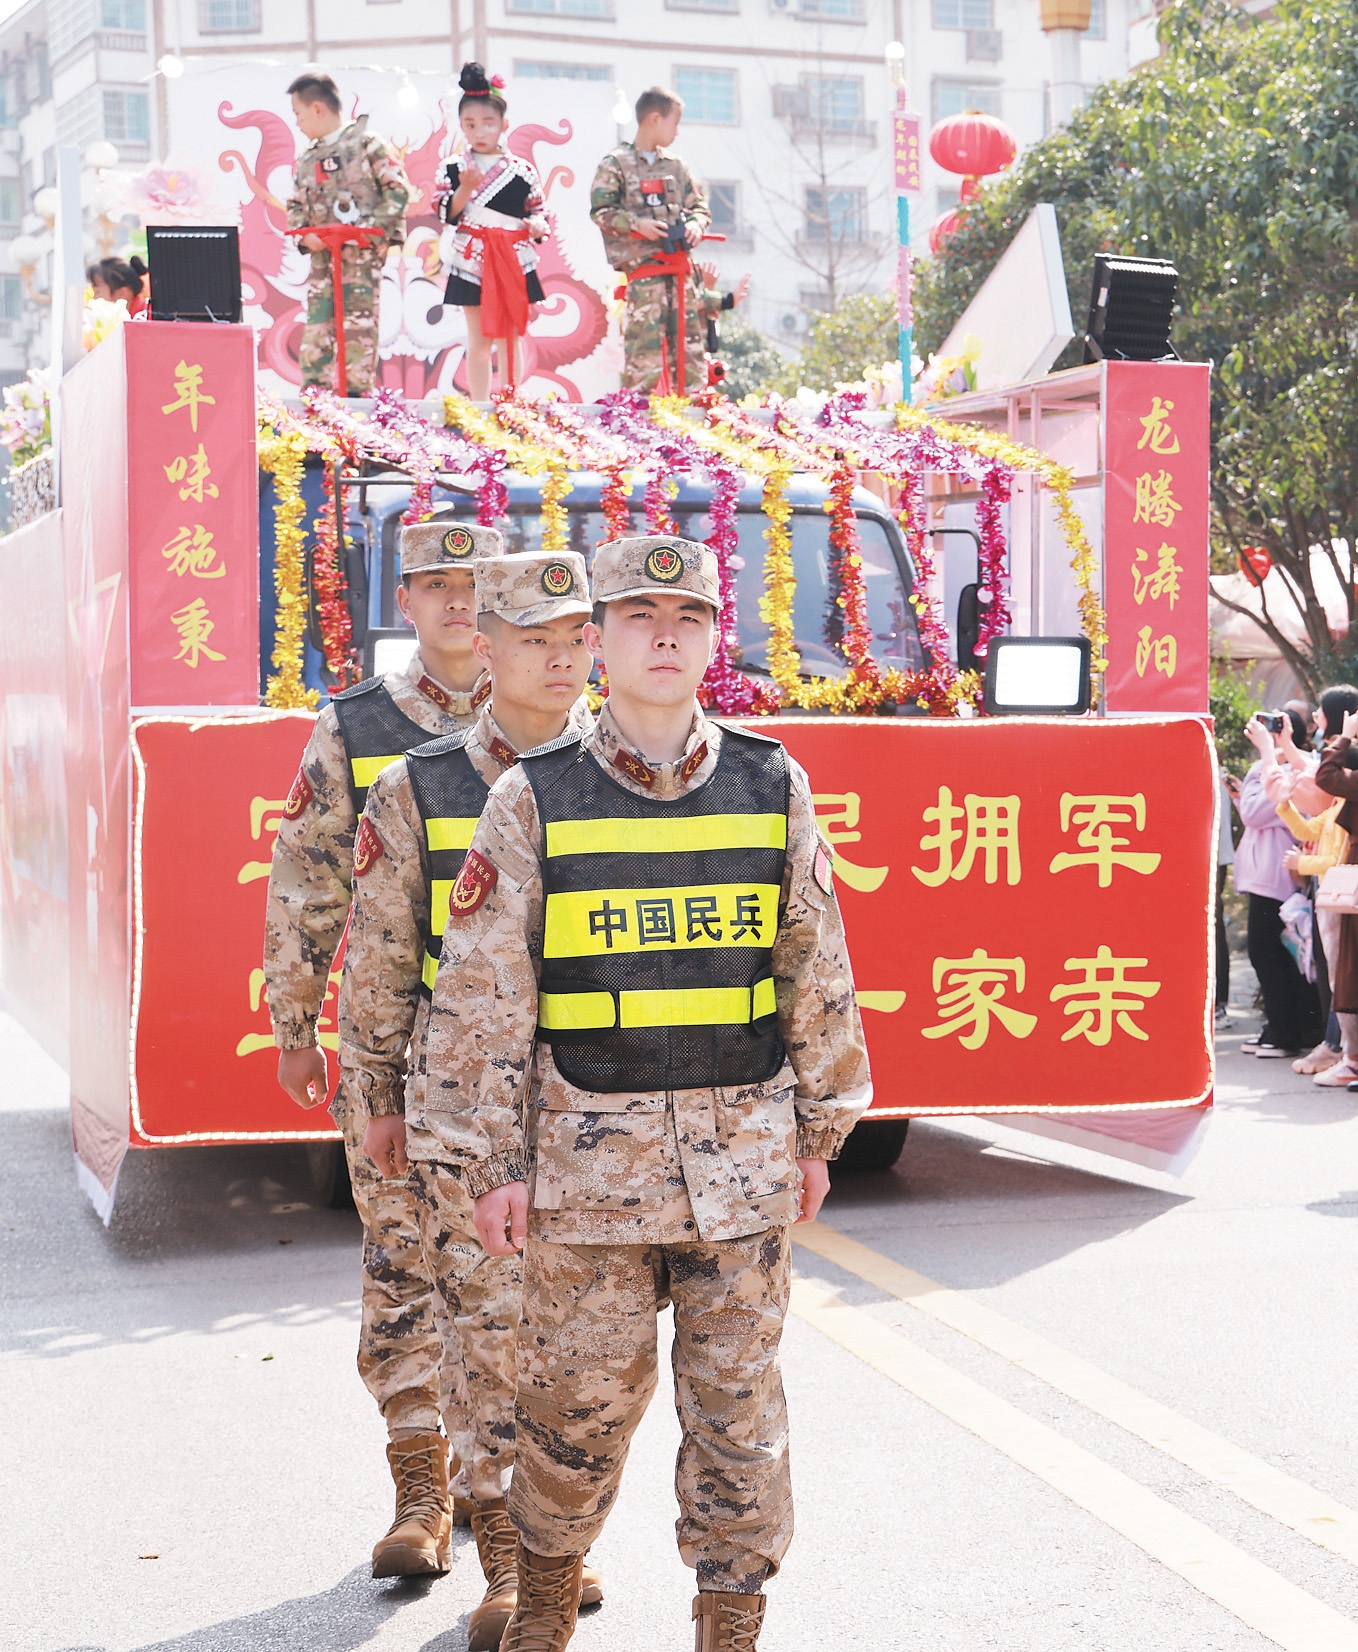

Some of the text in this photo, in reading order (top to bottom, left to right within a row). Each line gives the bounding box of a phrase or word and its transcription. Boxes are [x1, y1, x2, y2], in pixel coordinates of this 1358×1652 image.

[162, 360, 227, 668] 年味施秉
[588, 893, 763, 948] 中国民兵
